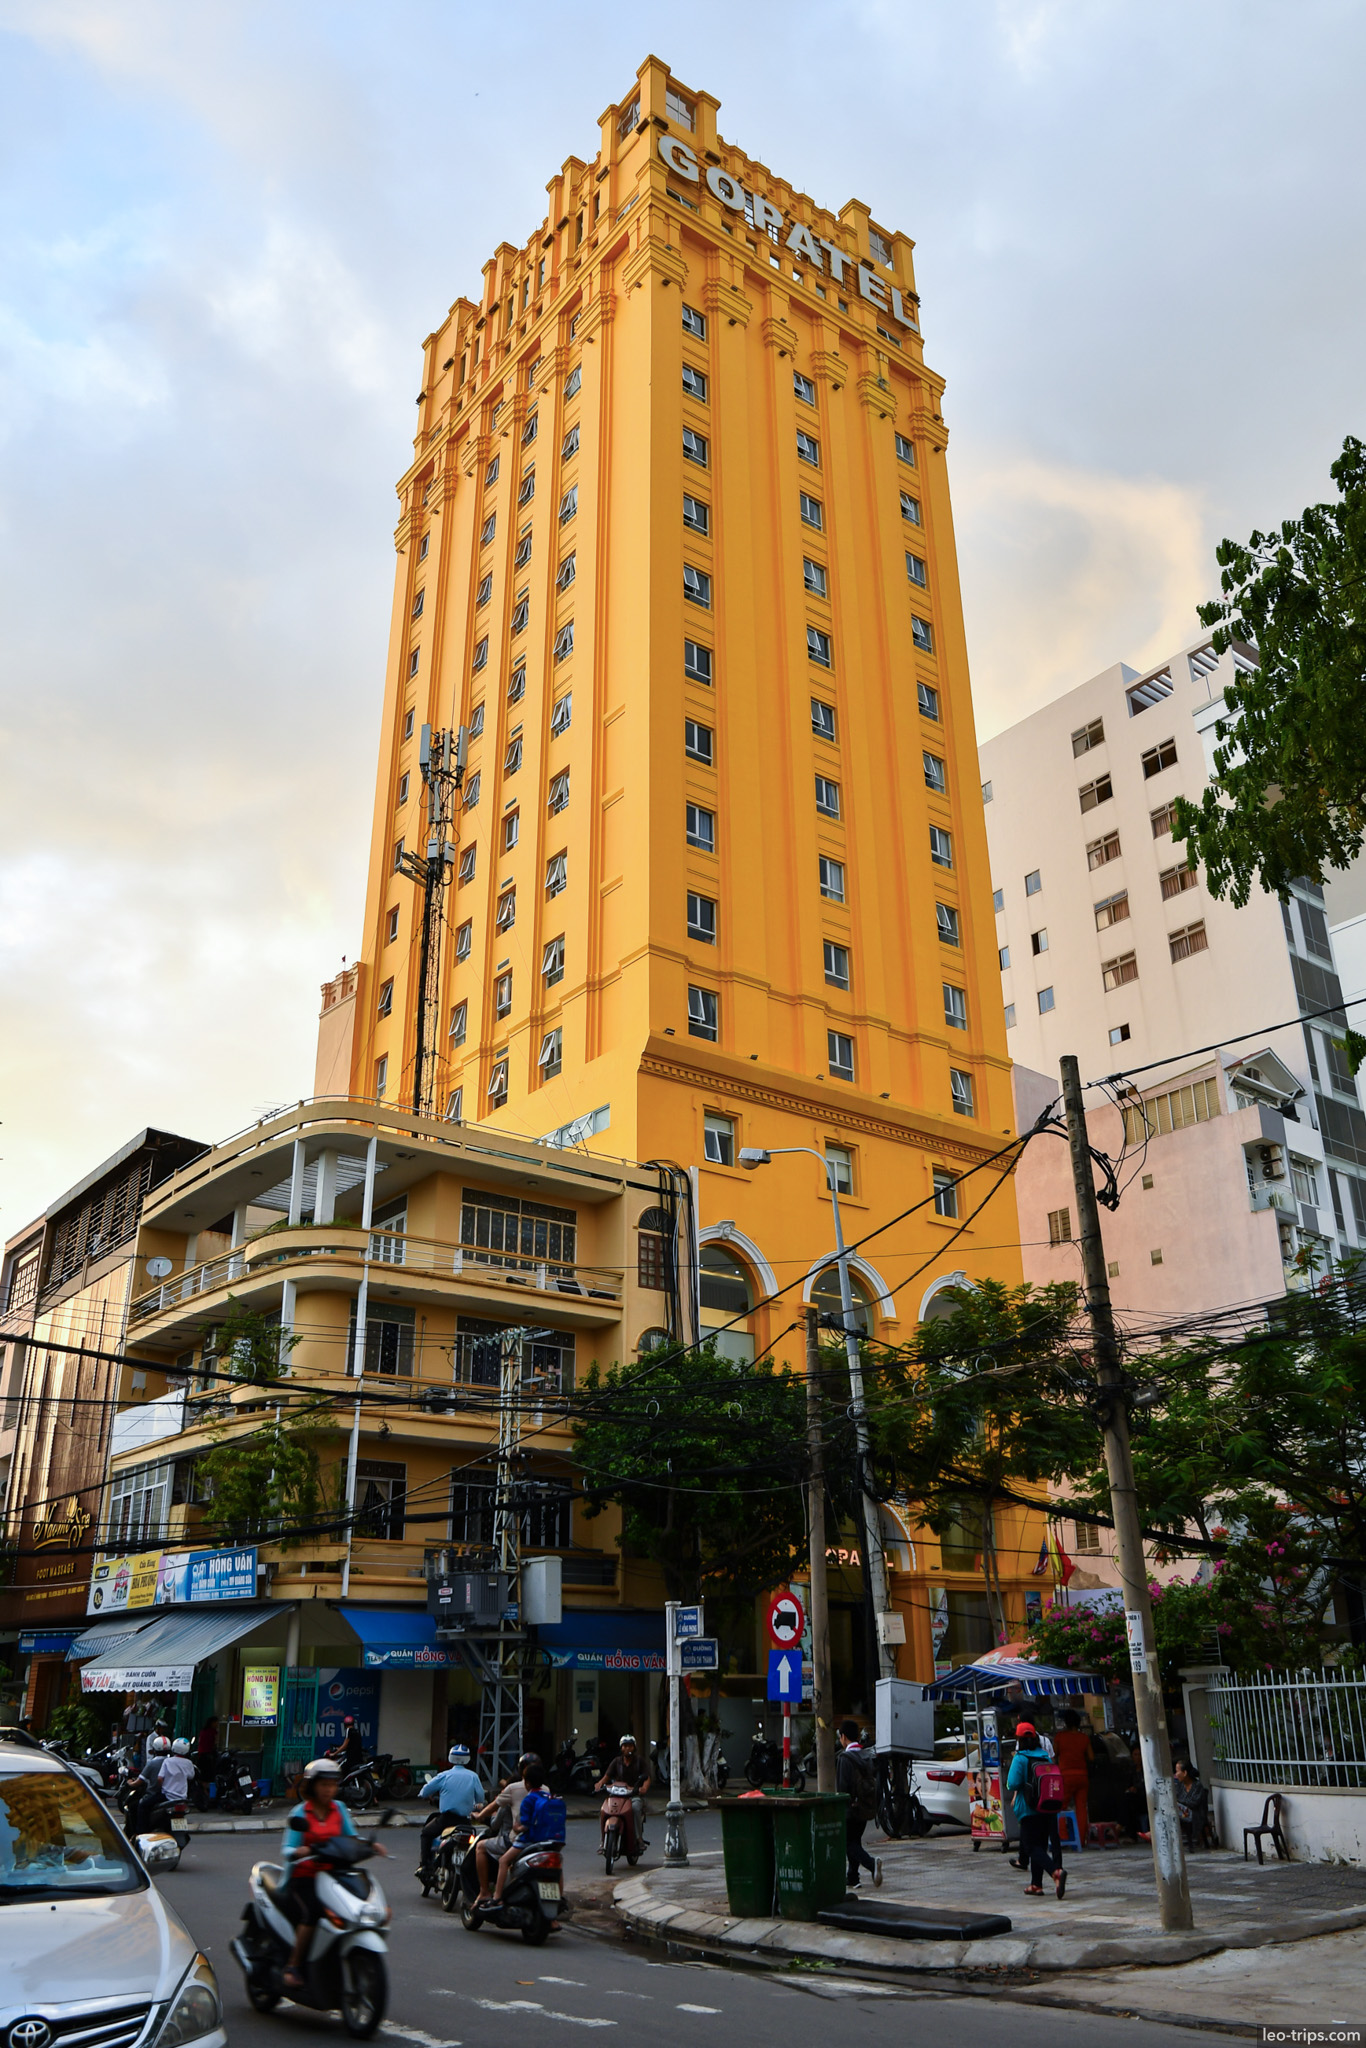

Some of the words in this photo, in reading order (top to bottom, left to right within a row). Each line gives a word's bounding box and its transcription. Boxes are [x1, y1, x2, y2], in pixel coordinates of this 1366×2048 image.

[658, 135, 919, 333] GOPATEL
[49, 1562, 76, 1577] MASSAGE
[390, 1649, 413, 1657] QUÁN
[414, 1645, 446, 1663] HỒNG
[577, 1652, 603, 1661] QUÁN
[605, 1648, 640, 1669] HỒNG
[346, 1686, 374, 1696] pepsi
